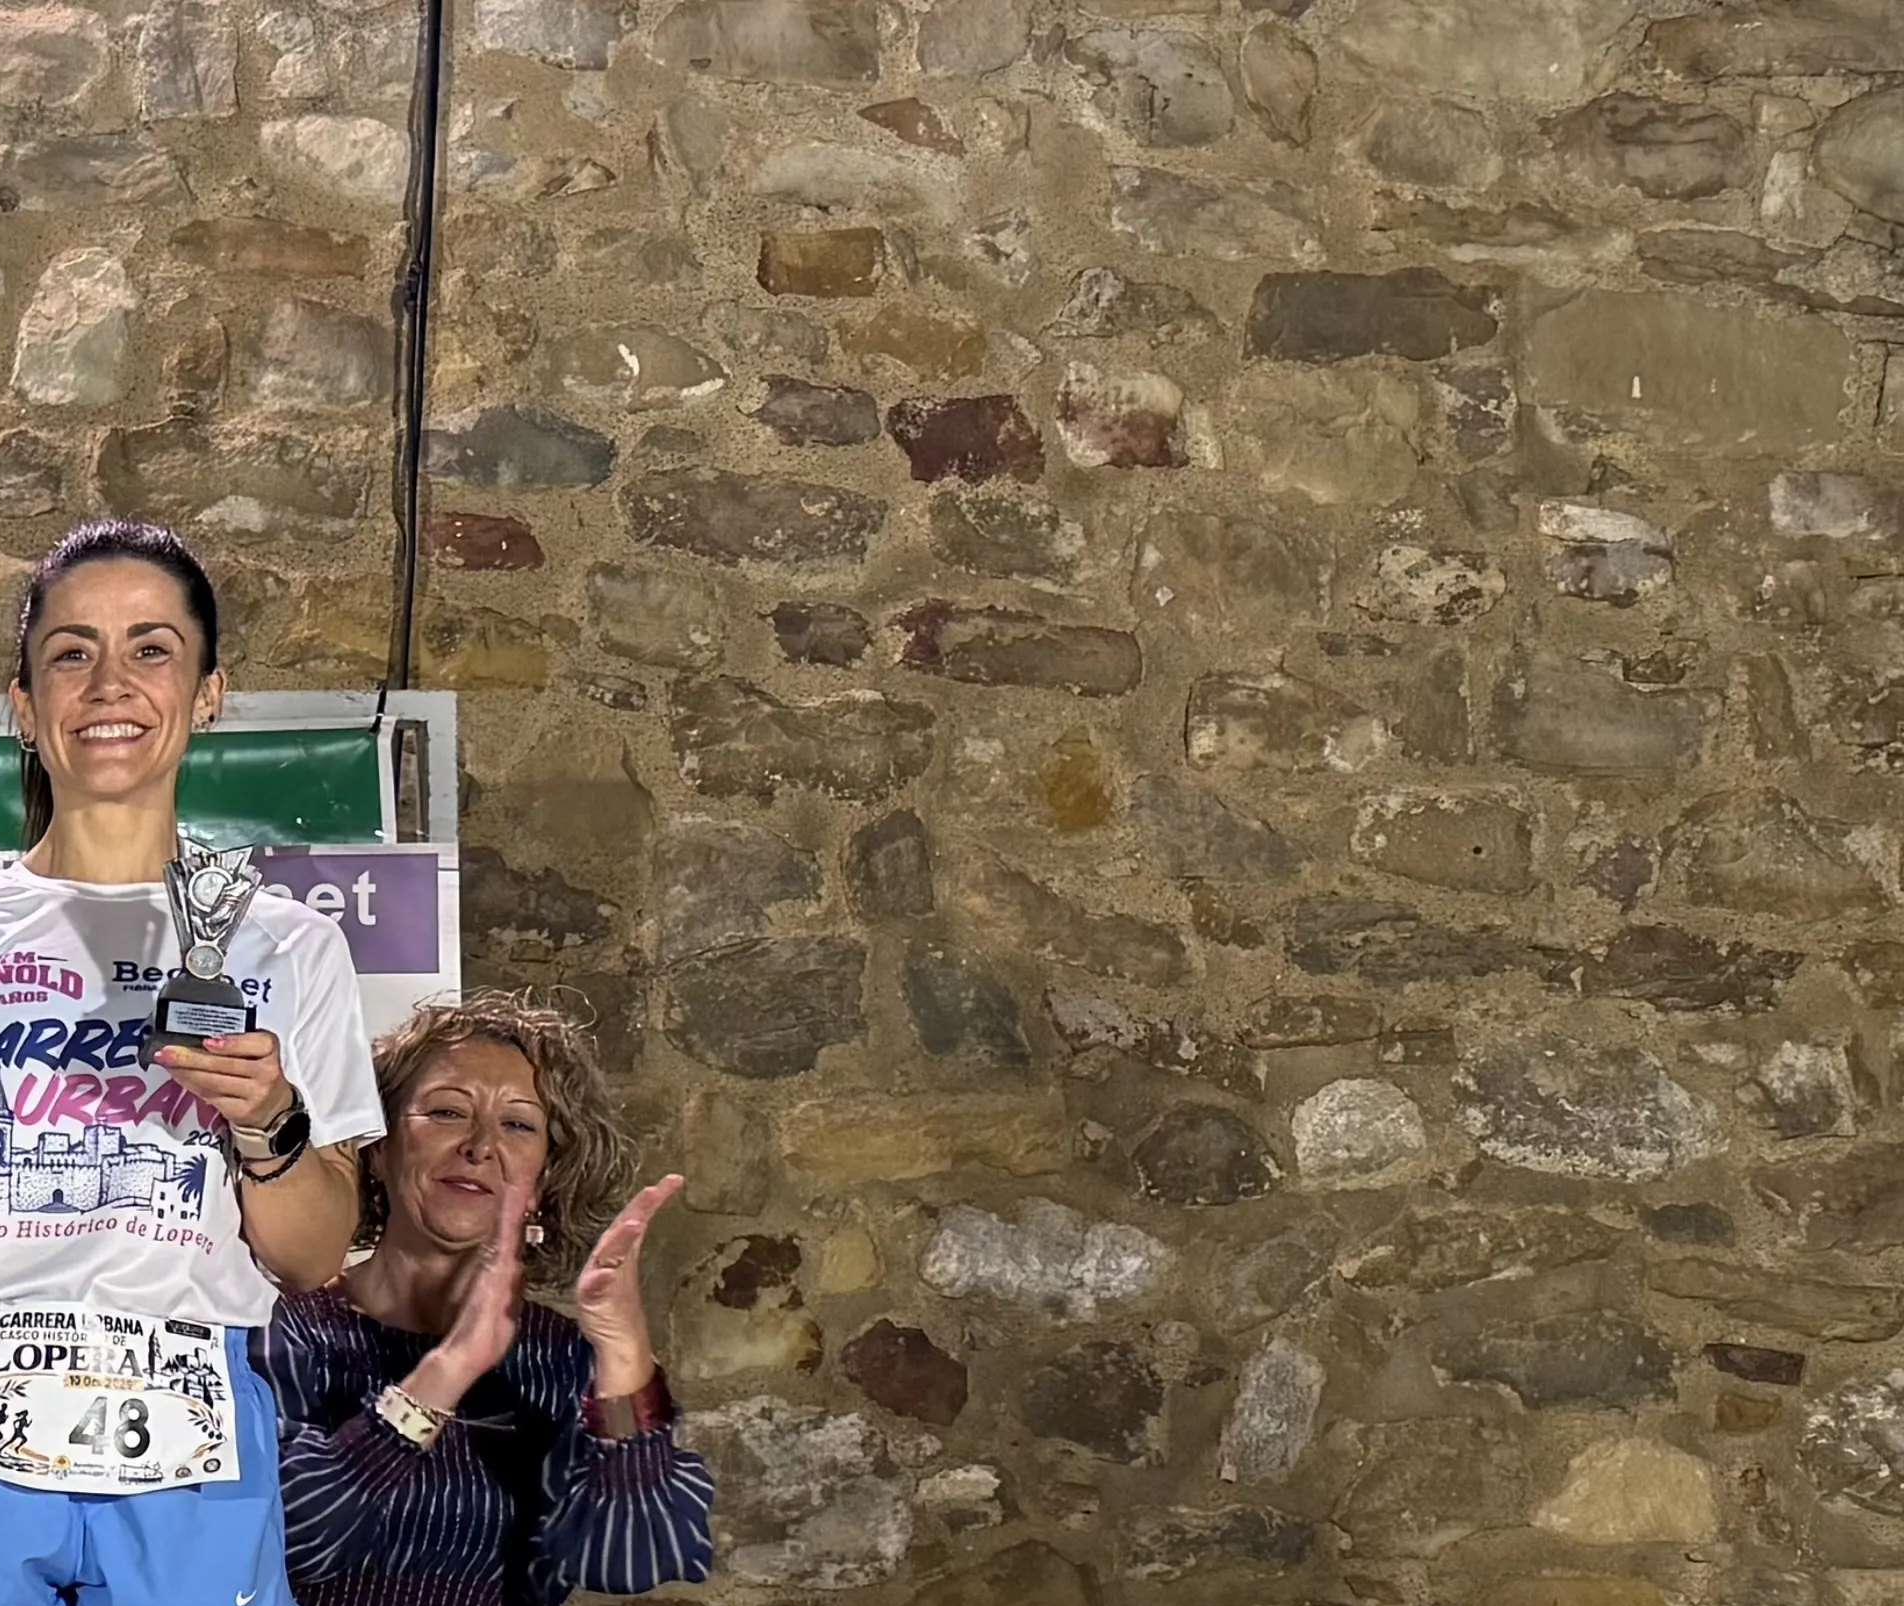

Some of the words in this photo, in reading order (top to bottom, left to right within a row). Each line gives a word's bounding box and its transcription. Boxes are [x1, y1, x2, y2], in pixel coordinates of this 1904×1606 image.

[13, 1073, 229, 1131] URBAN
[15, 1216, 118, 1239] Histórico
[126, 1215, 147, 1237] de
[153, 1223, 214, 1256] Lopera
[0, 1330, 40, 1342] CASCO
[68, 1396, 151, 1459] 48
